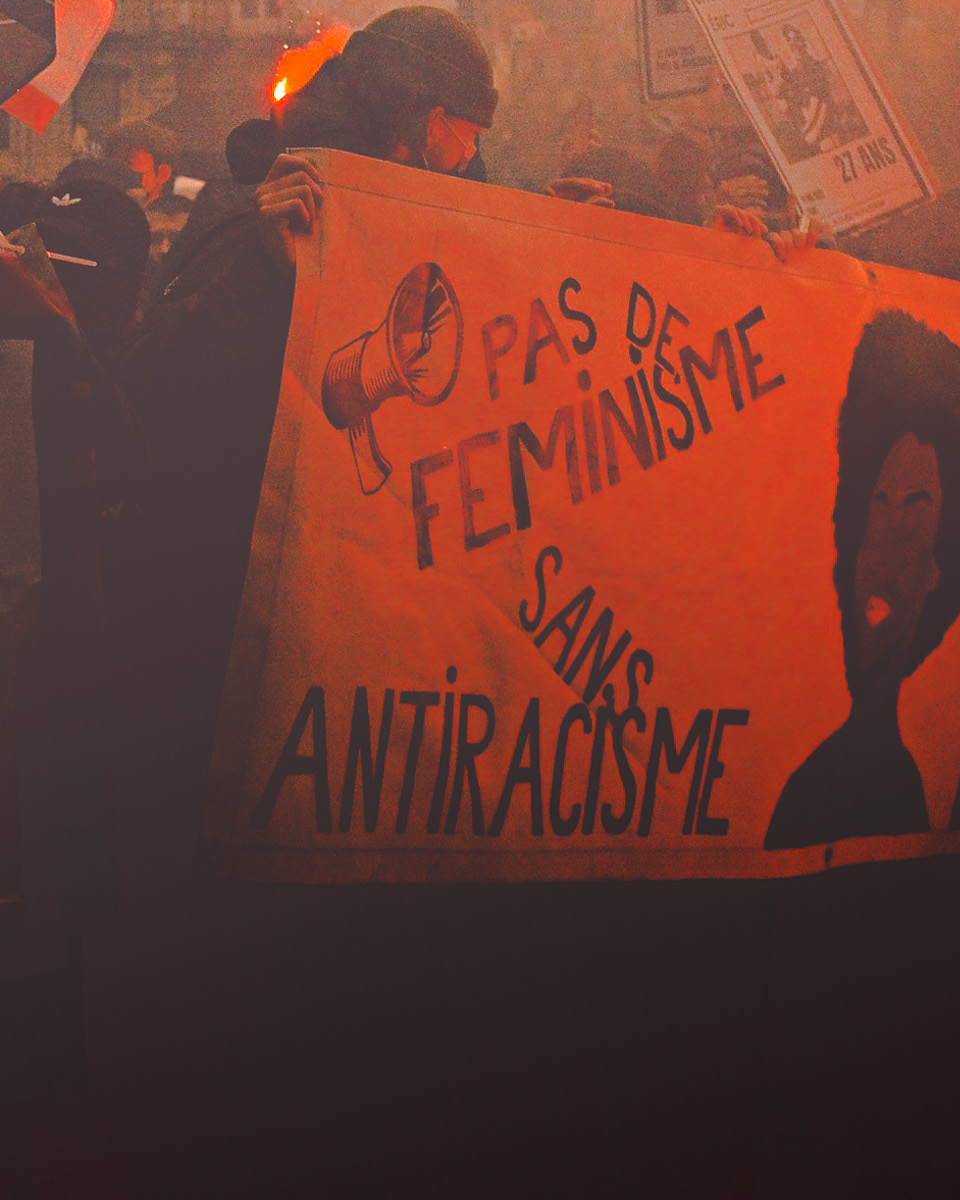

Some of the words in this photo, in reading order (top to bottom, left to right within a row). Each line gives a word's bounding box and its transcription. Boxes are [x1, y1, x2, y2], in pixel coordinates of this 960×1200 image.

[834, 150, 858, 183] 27
[857, 137, 897, 174] ANS
[481, 277, 597, 401] PAS
[625, 281, 690, 377] DE
[519, 545, 654, 721] SANS
